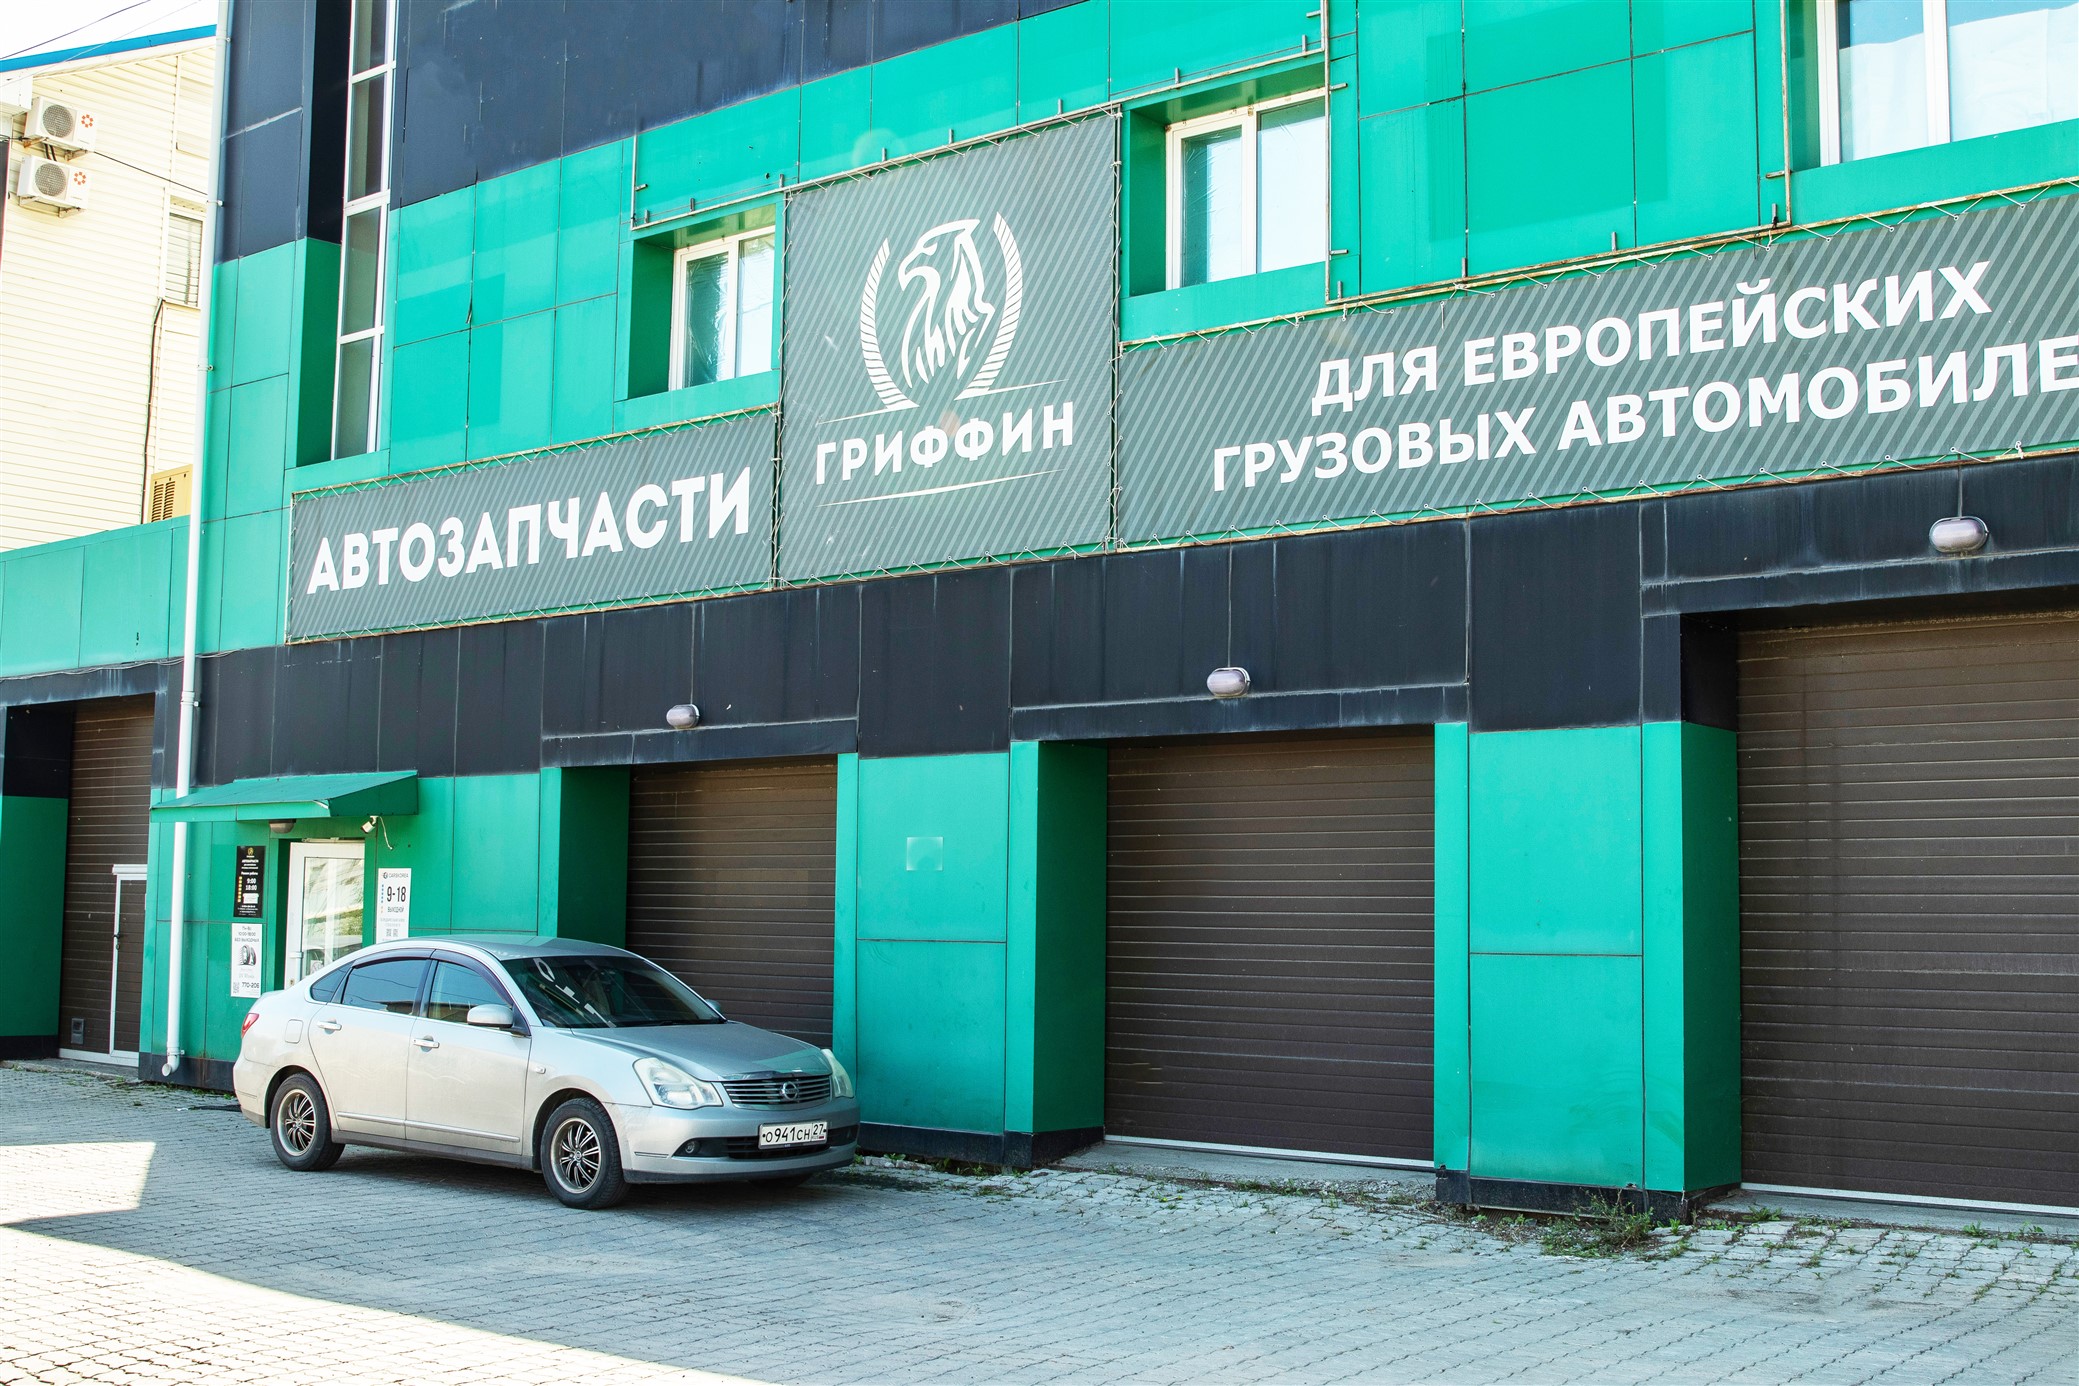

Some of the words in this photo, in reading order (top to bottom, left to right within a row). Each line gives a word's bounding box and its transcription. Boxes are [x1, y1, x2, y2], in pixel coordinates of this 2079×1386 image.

[1312, 345, 1437, 416] ДЛЯ
[1464, 261, 1992, 386] ЕВРОПЕЙСКИХ
[816, 401, 1073, 485] ГРИФФИН
[1214, 407, 1537, 491] ГРУЗОВЫХ
[1557, 335, 2079, 450] АВТОМОБИЛЕ
[307, 466, 750, 594] АВТОЗАПЧАСТИ
[387, 886, 406, 902] 9-18
